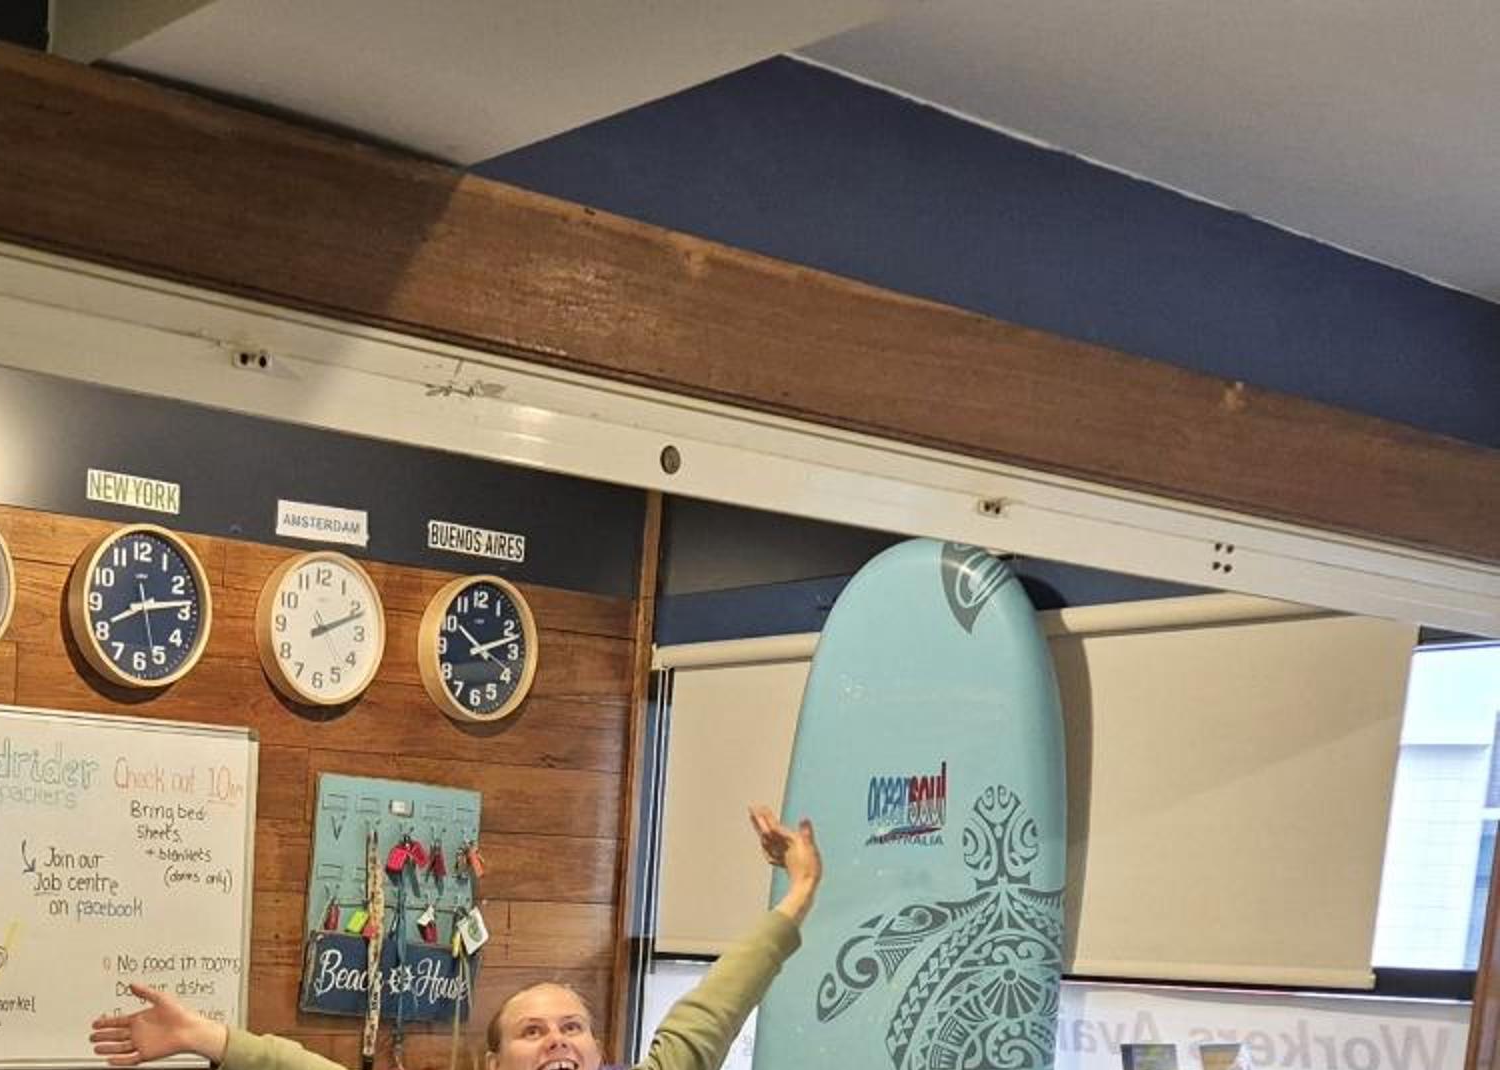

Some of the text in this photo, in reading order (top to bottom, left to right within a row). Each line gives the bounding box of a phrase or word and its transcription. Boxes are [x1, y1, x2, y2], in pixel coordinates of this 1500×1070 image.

[89, 471, 180, 513] NEW YORK
[283, 513, 360, 535] AMSTERDAM
[431, 523, 524, 560] BUENOS AIRES
[113, 547, 127, 568] 11
[133, 541, 153, 562] 12
[95, 568, 115, 587] 10
[171, 575, 185, 595] 2
[299, 573, 310, 590] 11
[315, 567, 333, 586] 12
[89, 592, 103, 612] 9
[281, 591, 299, 609] 10
[350, 600, 361, 617] 2
[457, 596, 469, 614] 11
[473, 591, 489, 609] 12
[177, 603, 191, 621] 3
[96, 621, 109, 641] 8
[275, 614, 287, 632] 9
[442, 615, 458, 633] 10
[504, 620, 516, 637] 2
[169, 629, 183, 647] 4
[353, 625, 365, 643] 3
[111, 642, 125, 660] 7
[280, 642, 292, 659] 8
[438, 637, 448, 655] 9
[507, 644, 519, 661] 3
[133, 652, 147, 672] 6
[152, 646, 166, 665] 5
[345, 651, 356, 667] 4
[294, 661, 305, 679] 7
[330, 667, 341, 684] 5
[441, 663, 453, 680] 8
[500, 668, 512, 684] 4
[311, 671, 323, 689] 6
[454, 681, 464, 698] 7
[469, 689, 481, 706] 6
[485, 683, 498, 700] 5
[114, 757, 164, 793] Check
[171, 766, 196, 794] out
[130, 800, 206, 824] Bring bed
[44, 846, 107, 870] Join our
[33, 872, 119, 896] Job centre
[49, 896, 143, 922] on facebook
[117, 954, 241, 975] No food in rooms
[176, 978, 216, 996] dishes
